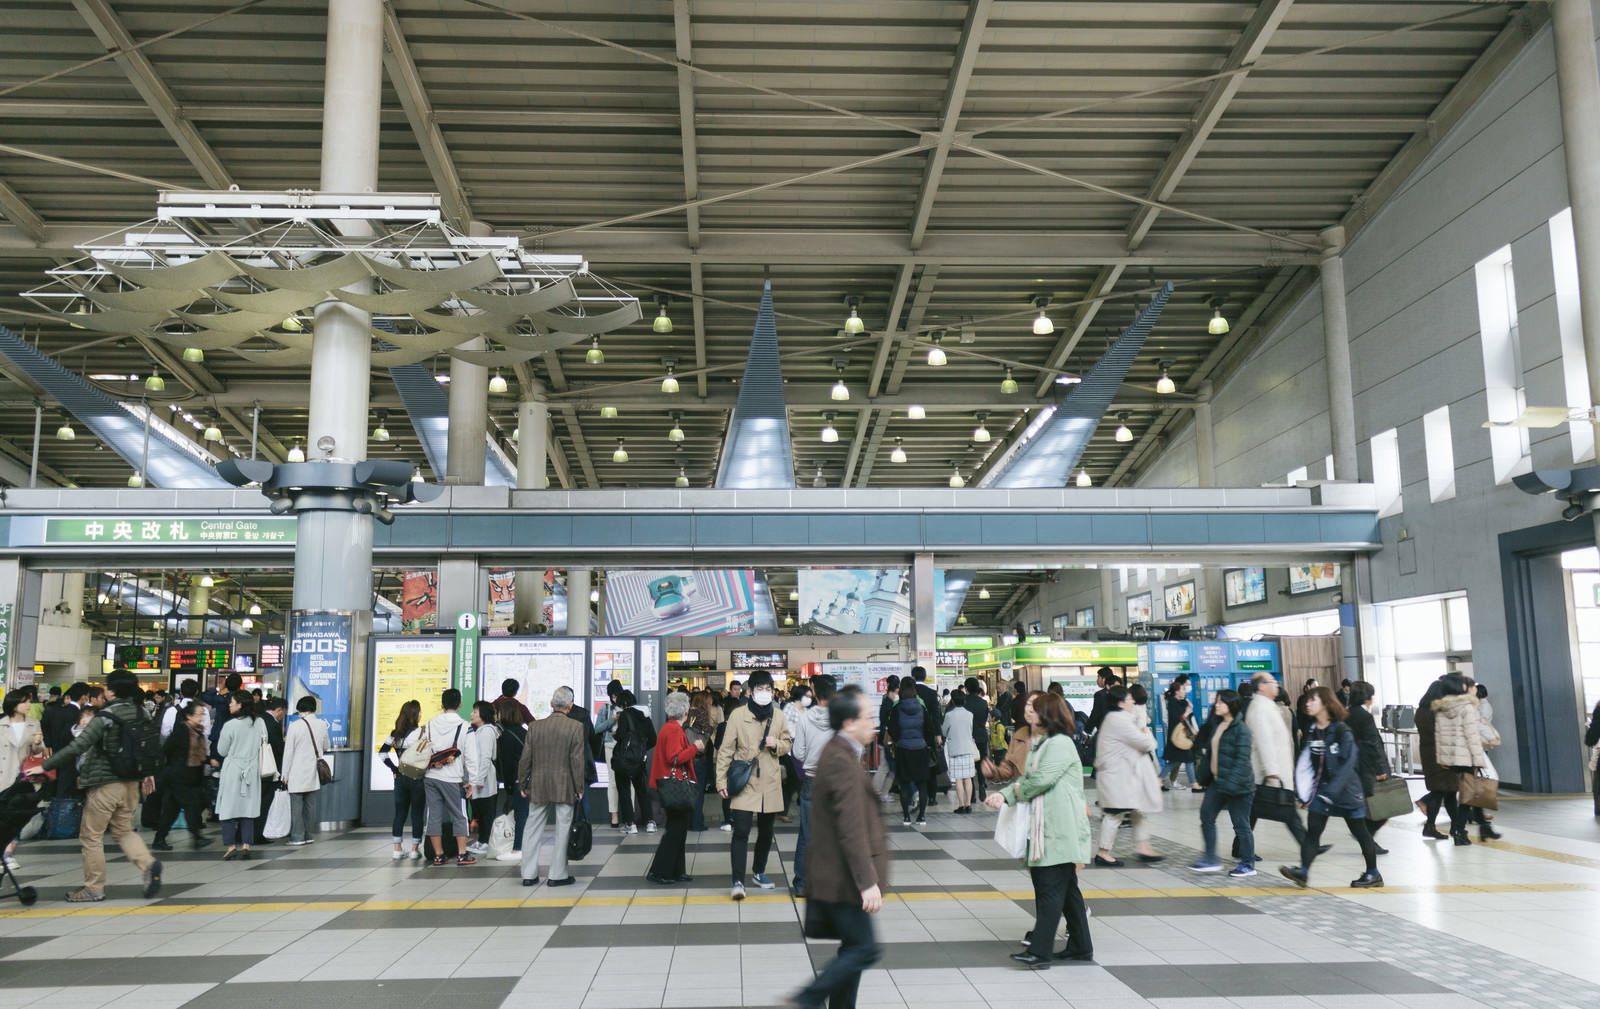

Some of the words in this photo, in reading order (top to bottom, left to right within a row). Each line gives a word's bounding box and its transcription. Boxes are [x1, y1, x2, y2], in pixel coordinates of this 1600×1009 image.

[84, 521, 189, 541] 中央改札
[200, 521, 233, 530] Central
[236, 521, 258, 530] Gate
[292, 640, 347, 653] GOOS
